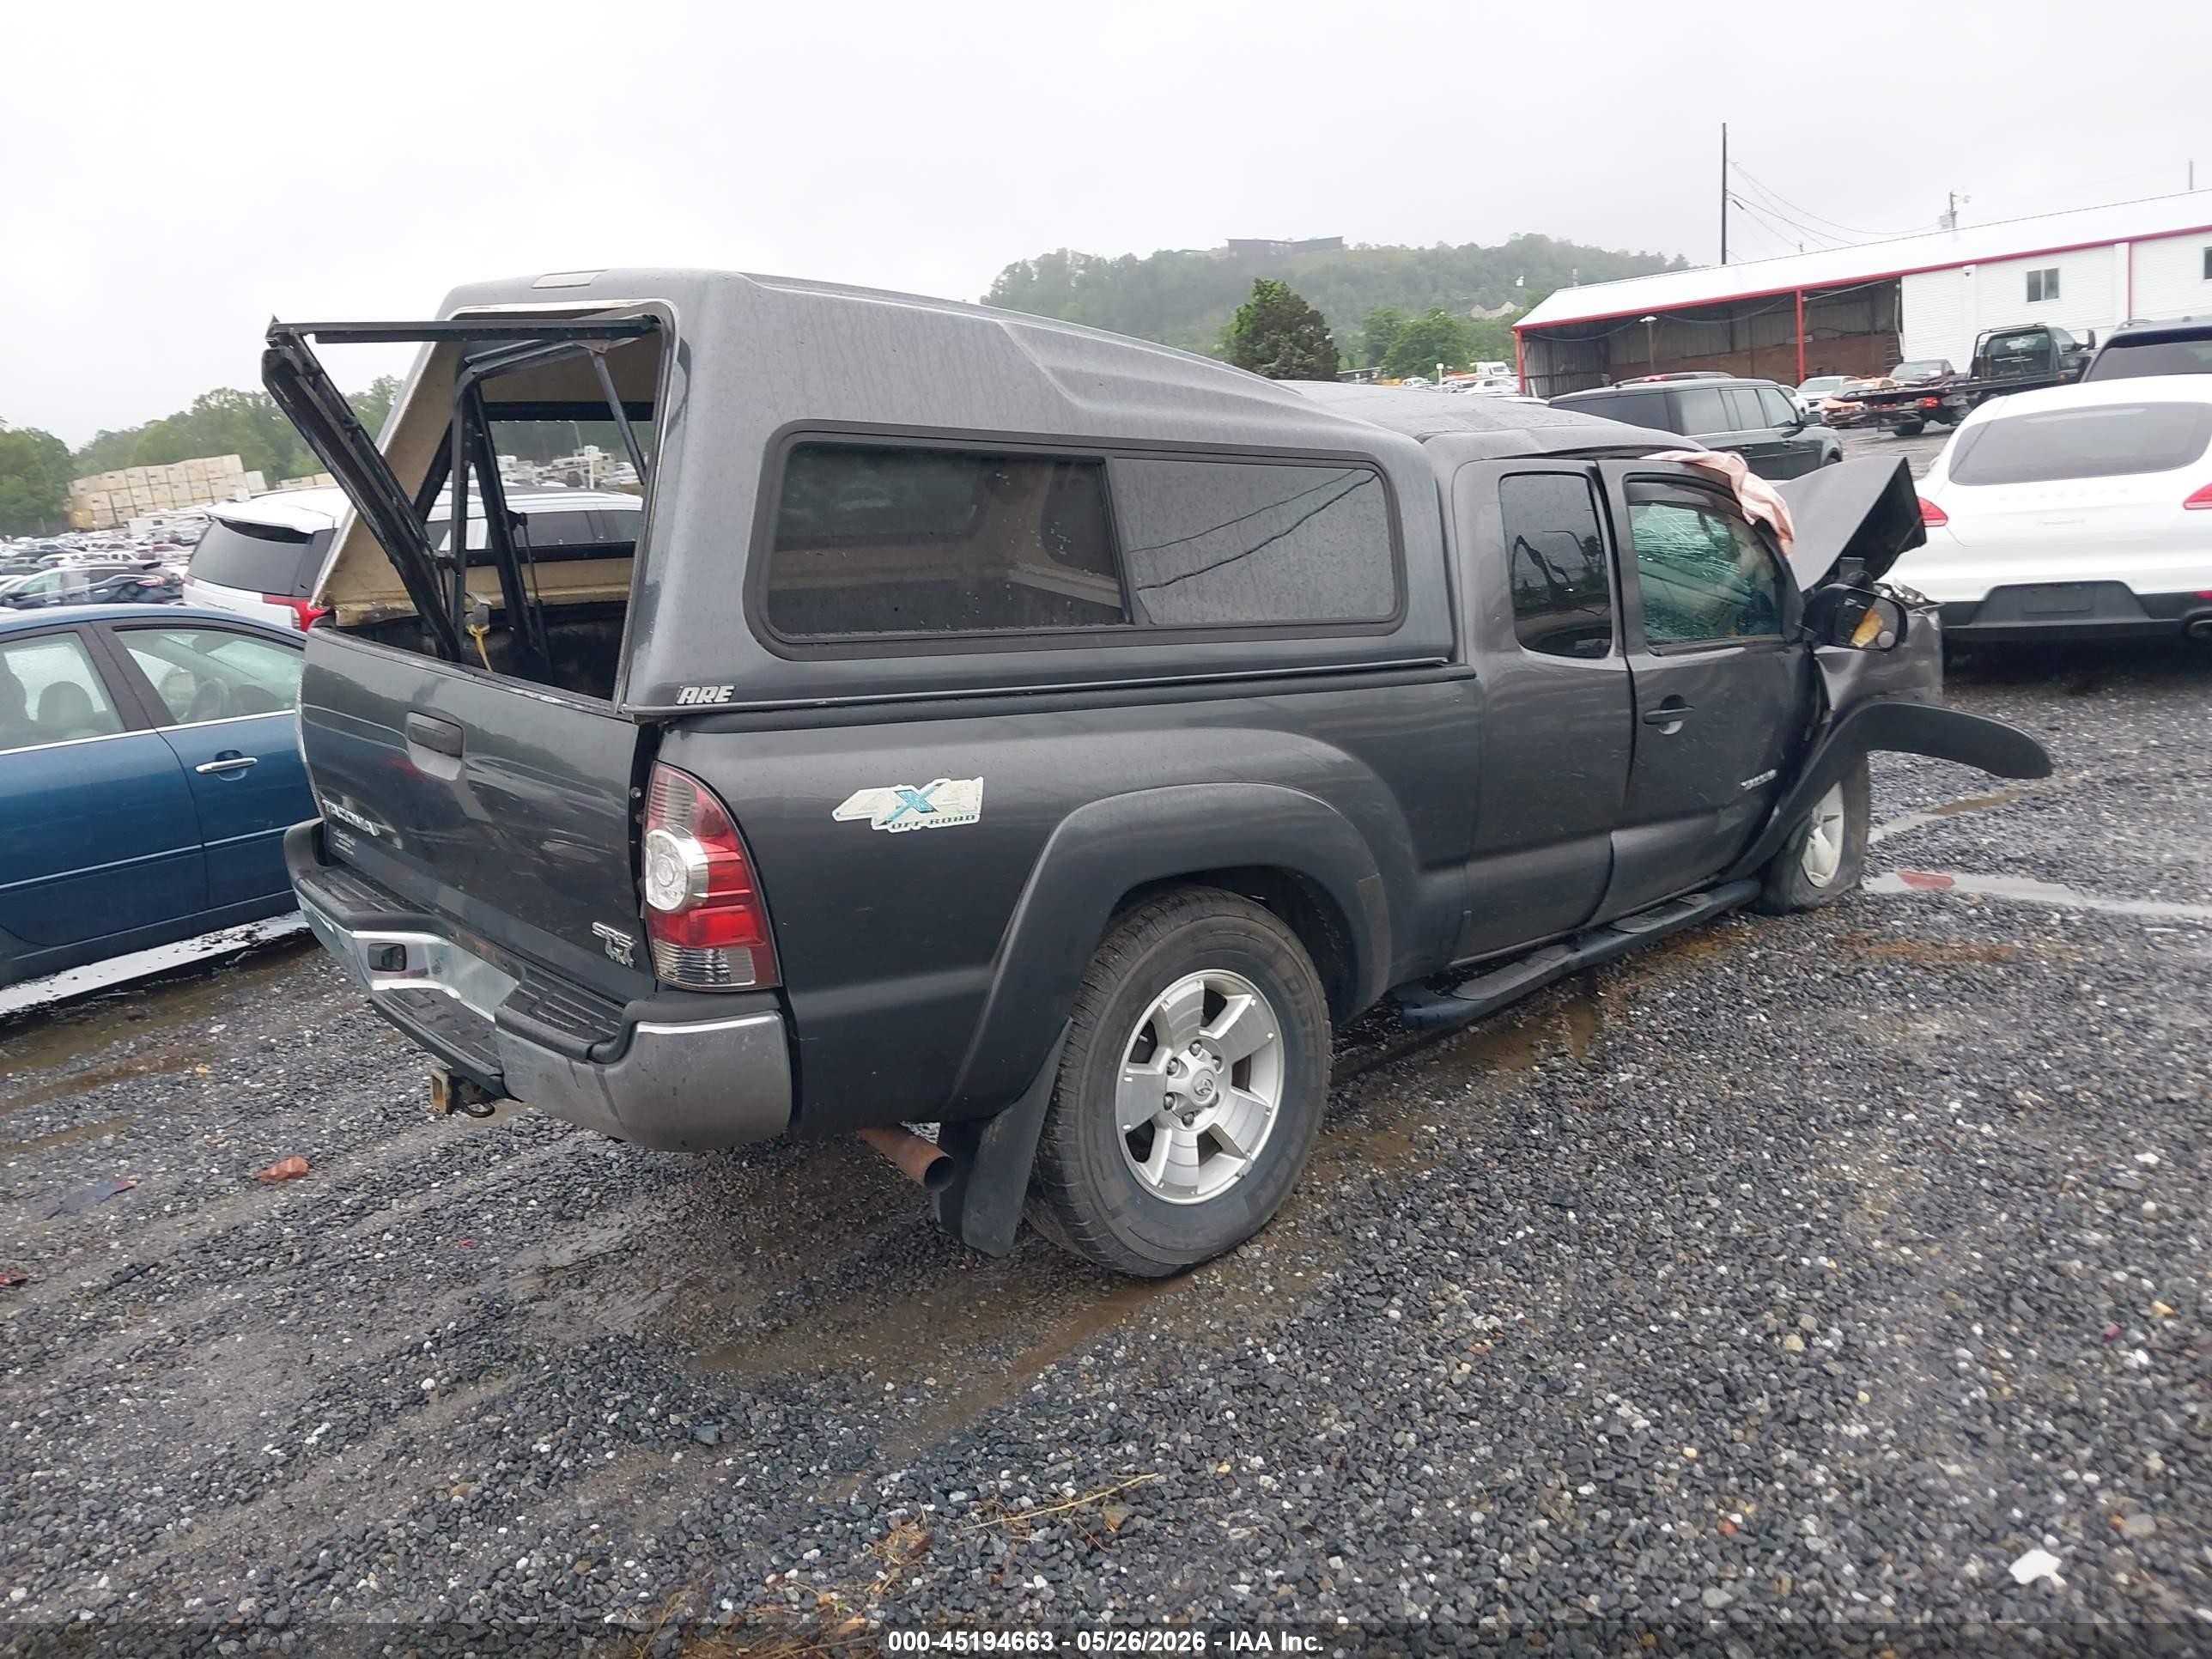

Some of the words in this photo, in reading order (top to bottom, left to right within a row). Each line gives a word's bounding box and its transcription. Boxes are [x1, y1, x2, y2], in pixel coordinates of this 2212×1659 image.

[676, 685, 735, 704] ARE
[321, 798, 380, 836] TACOMA
[890, 820, 921, 830] OFF
[929, 814, 976, 826] ROAD
[592, 921, 634, 949] SR5
